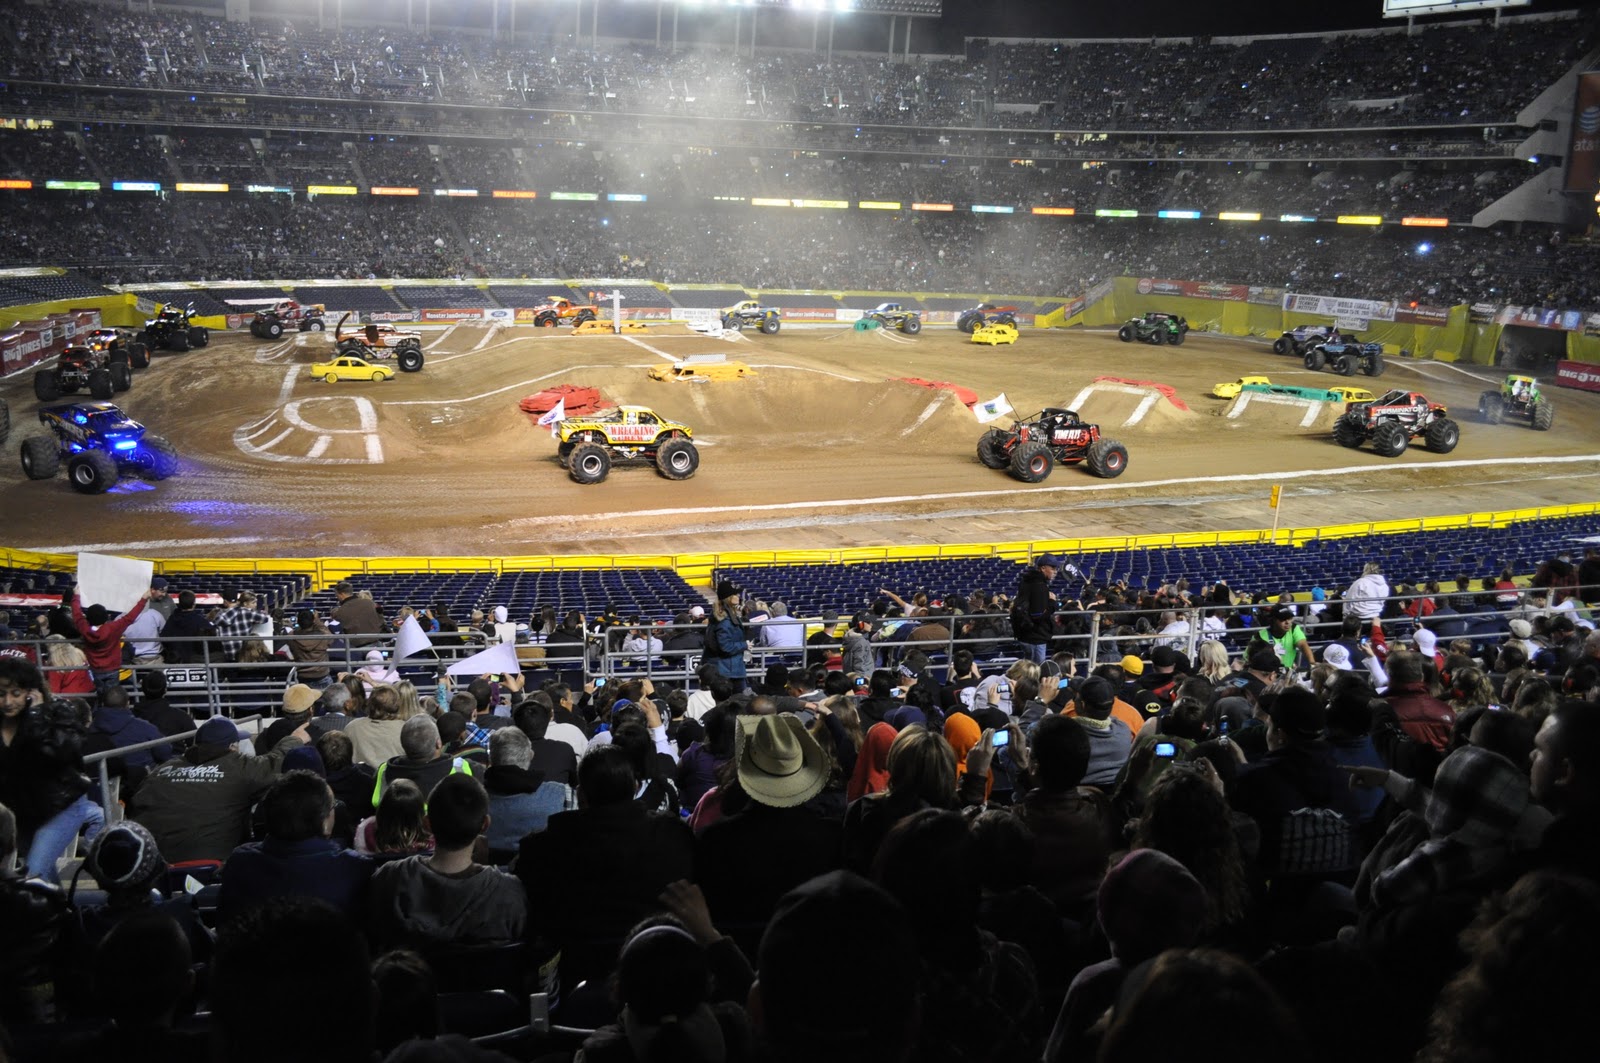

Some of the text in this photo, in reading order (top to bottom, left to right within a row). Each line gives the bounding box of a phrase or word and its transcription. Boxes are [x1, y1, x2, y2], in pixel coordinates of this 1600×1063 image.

[21, 340, 41, 355] TIRES
[1558, 369, 1578, 379] BIG
[1376, 406, 1424, 415] TERMINATOR
[611, 426, 655, 435] WRECKING
[0, 649, 27, 658] ELITE
